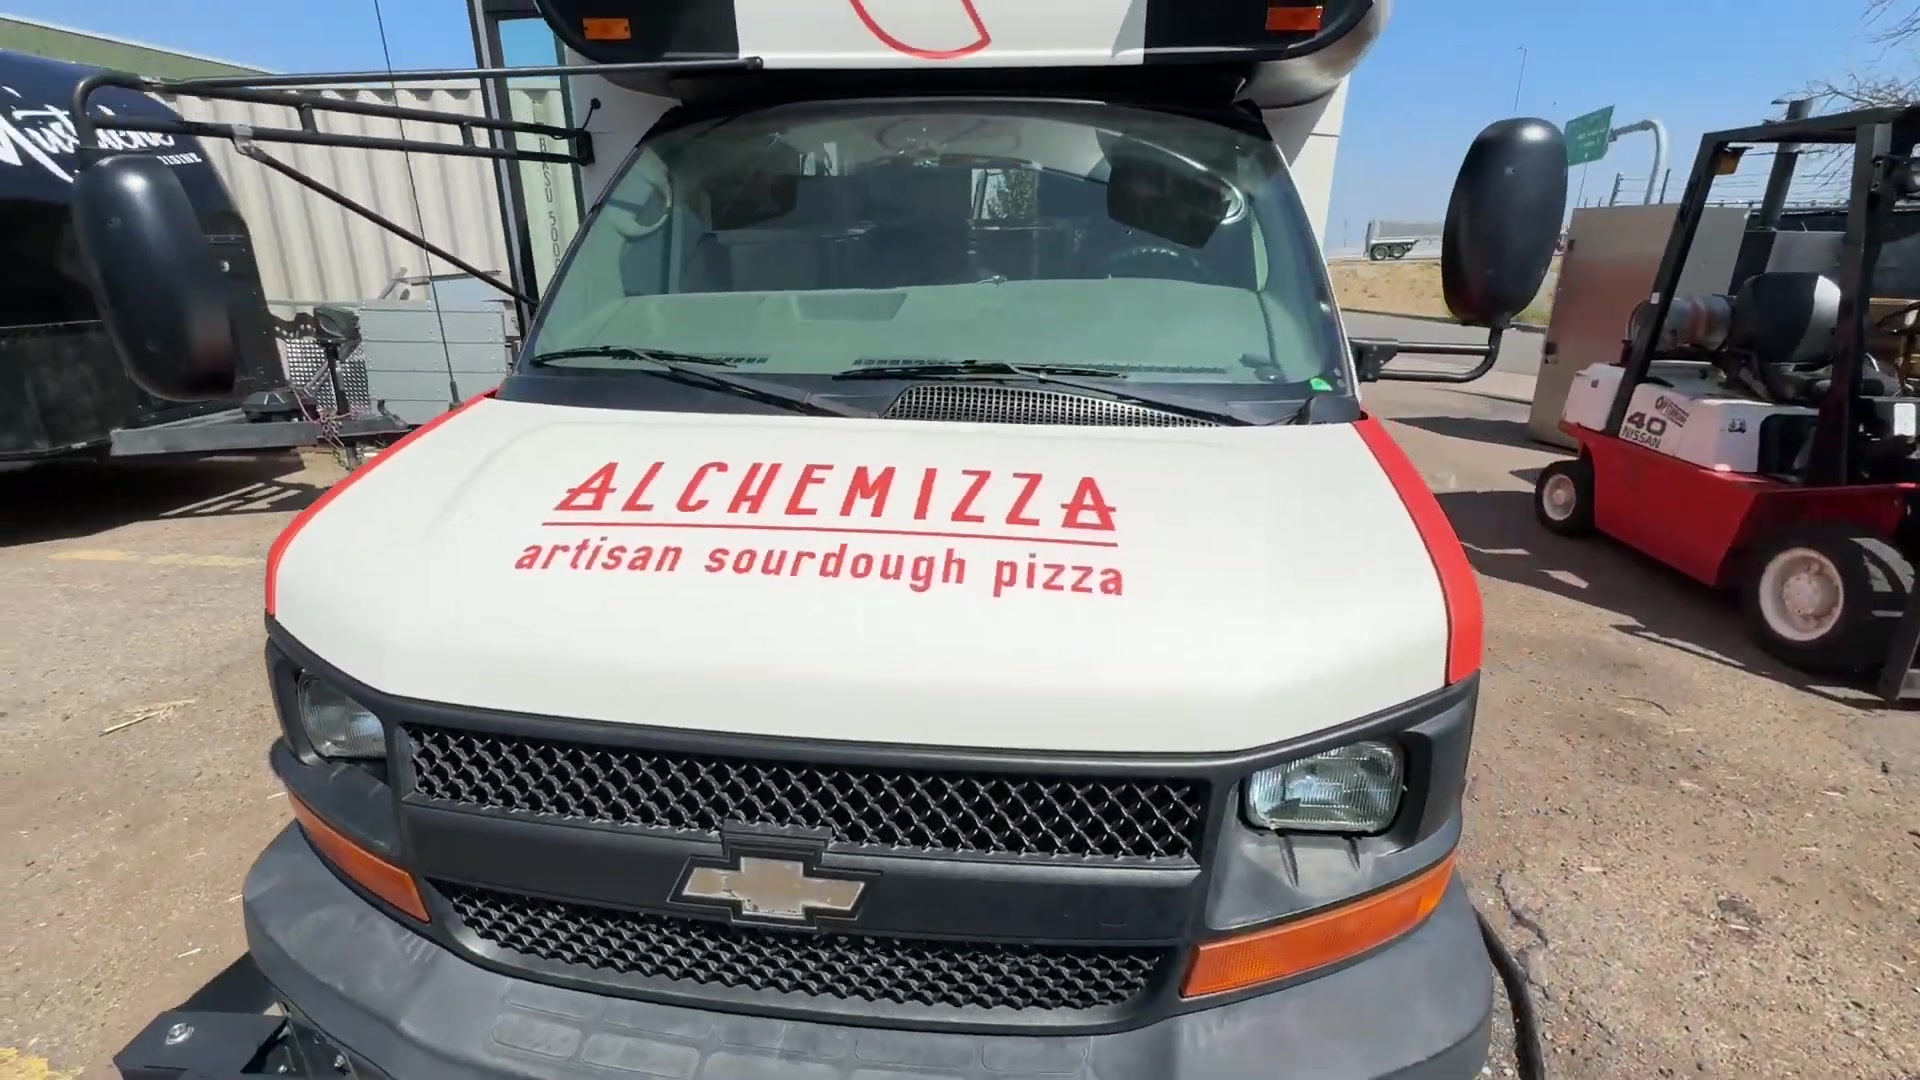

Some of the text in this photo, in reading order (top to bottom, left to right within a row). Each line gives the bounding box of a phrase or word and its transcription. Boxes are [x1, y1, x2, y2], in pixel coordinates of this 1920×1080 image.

[1620, 425, 1662, 449] NISSAN
[1627, 411, 1668, 437] 40
[553, 460, 1117, 531] ALCHEMIZZA
[514, 535, 1123, 598] artisan sourdough pizza
